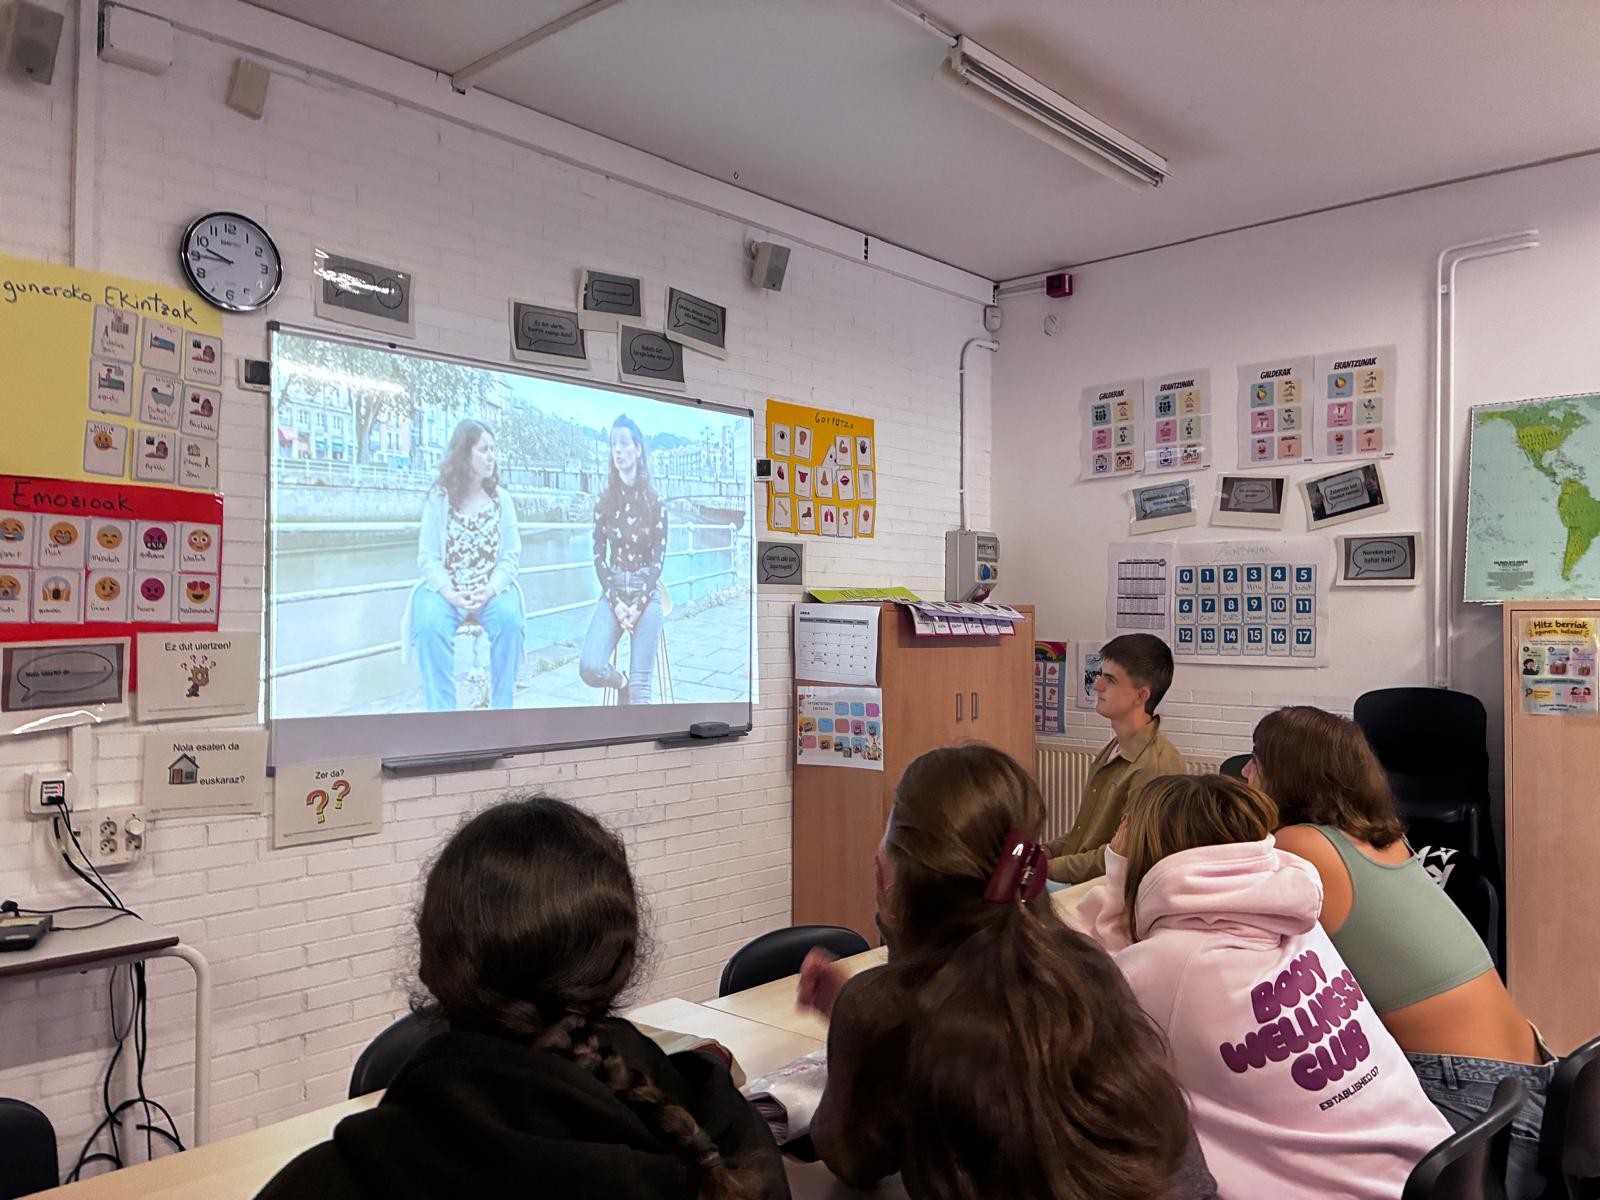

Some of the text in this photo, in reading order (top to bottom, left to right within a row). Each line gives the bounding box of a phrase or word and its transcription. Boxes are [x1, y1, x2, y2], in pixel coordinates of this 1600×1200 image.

[210, 223, 237, 236] 11 12
[196, 235, 209, 247] 10
[191, 250, 200, 261] 9
[254, 246, 263, 257] 2
[196, 267, 206, 278] 8
[260, 263, 268, 274] 3
[1333, 357, 1377, 370] ERANTZUNAK
[1260, 368, 1292, 380] GALDERAK
[1160, 379, 1194, 392] ERANTZUNAK
[1099, 389, 1125, 400] GALDERAK
[1183, 571, 1190, 581] 0
[1227, 570, 1234, 581] 2
[1250, 569, 1258, 579] 3
[1274, 569, 1282, 579] 4
[1300, 570, 1308, 580] 5
[1182, 599, 1309, 611] 6 7 8 9 10 11
[1533, 620, 1588, 629] Hitz berriak
[1180, 630, 1310, 642] 12 13 14 15 16 17
[164, 641, 232, 651] Ez dut ulertzen!
[172, 742, 240, 752] Nola esaten da
[315, 768, 345, 779] Zer da?
[199, 775, 246, 786] euskaraz?
[1251, 950, 1327, 1024] BODY
[1219, 969, 1364, 1073] WELLNESS
[1291, 1019, 1370, 1091] CLUB
[1319, 1066, 1379, 1111] ESTABLISHED 07
